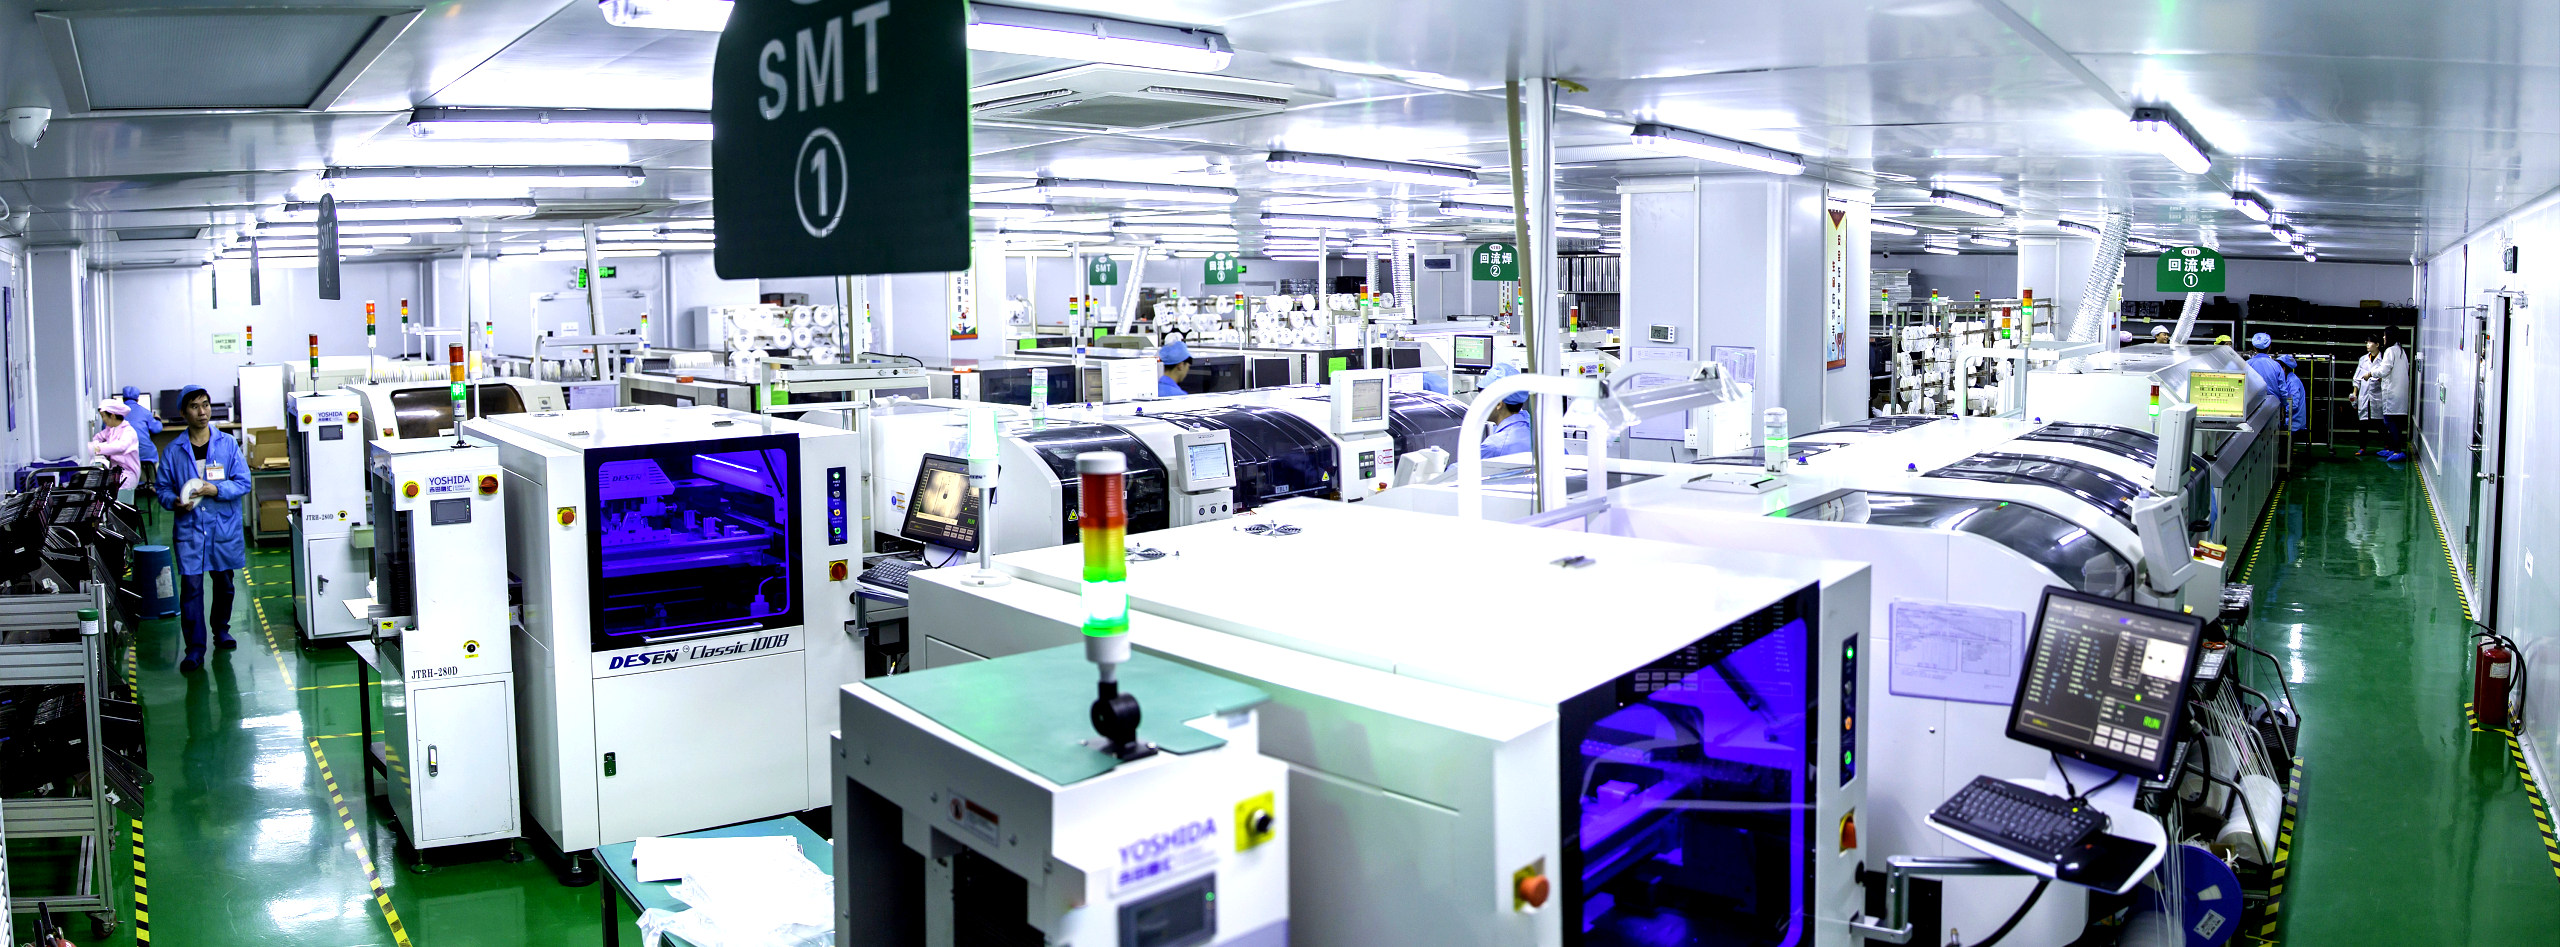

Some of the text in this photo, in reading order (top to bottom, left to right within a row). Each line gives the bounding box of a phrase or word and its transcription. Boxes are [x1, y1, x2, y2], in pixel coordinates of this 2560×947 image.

[758, 0, 890, 120] SMT
[1480, 252, 1513, 264] 回流焊
[2168, 258, 2216, 273] 回流焊
[1095, 264, 1111, 273] SMT
[429, 475, 471, 486] YOSHIDA
[608, 648, 680, 671] DESEN
[689, 641, 748, 660] Classic
[411, 665, 458, 680] JTRH-280D
[1118, 816, 1217, 864] YOSHIDA
